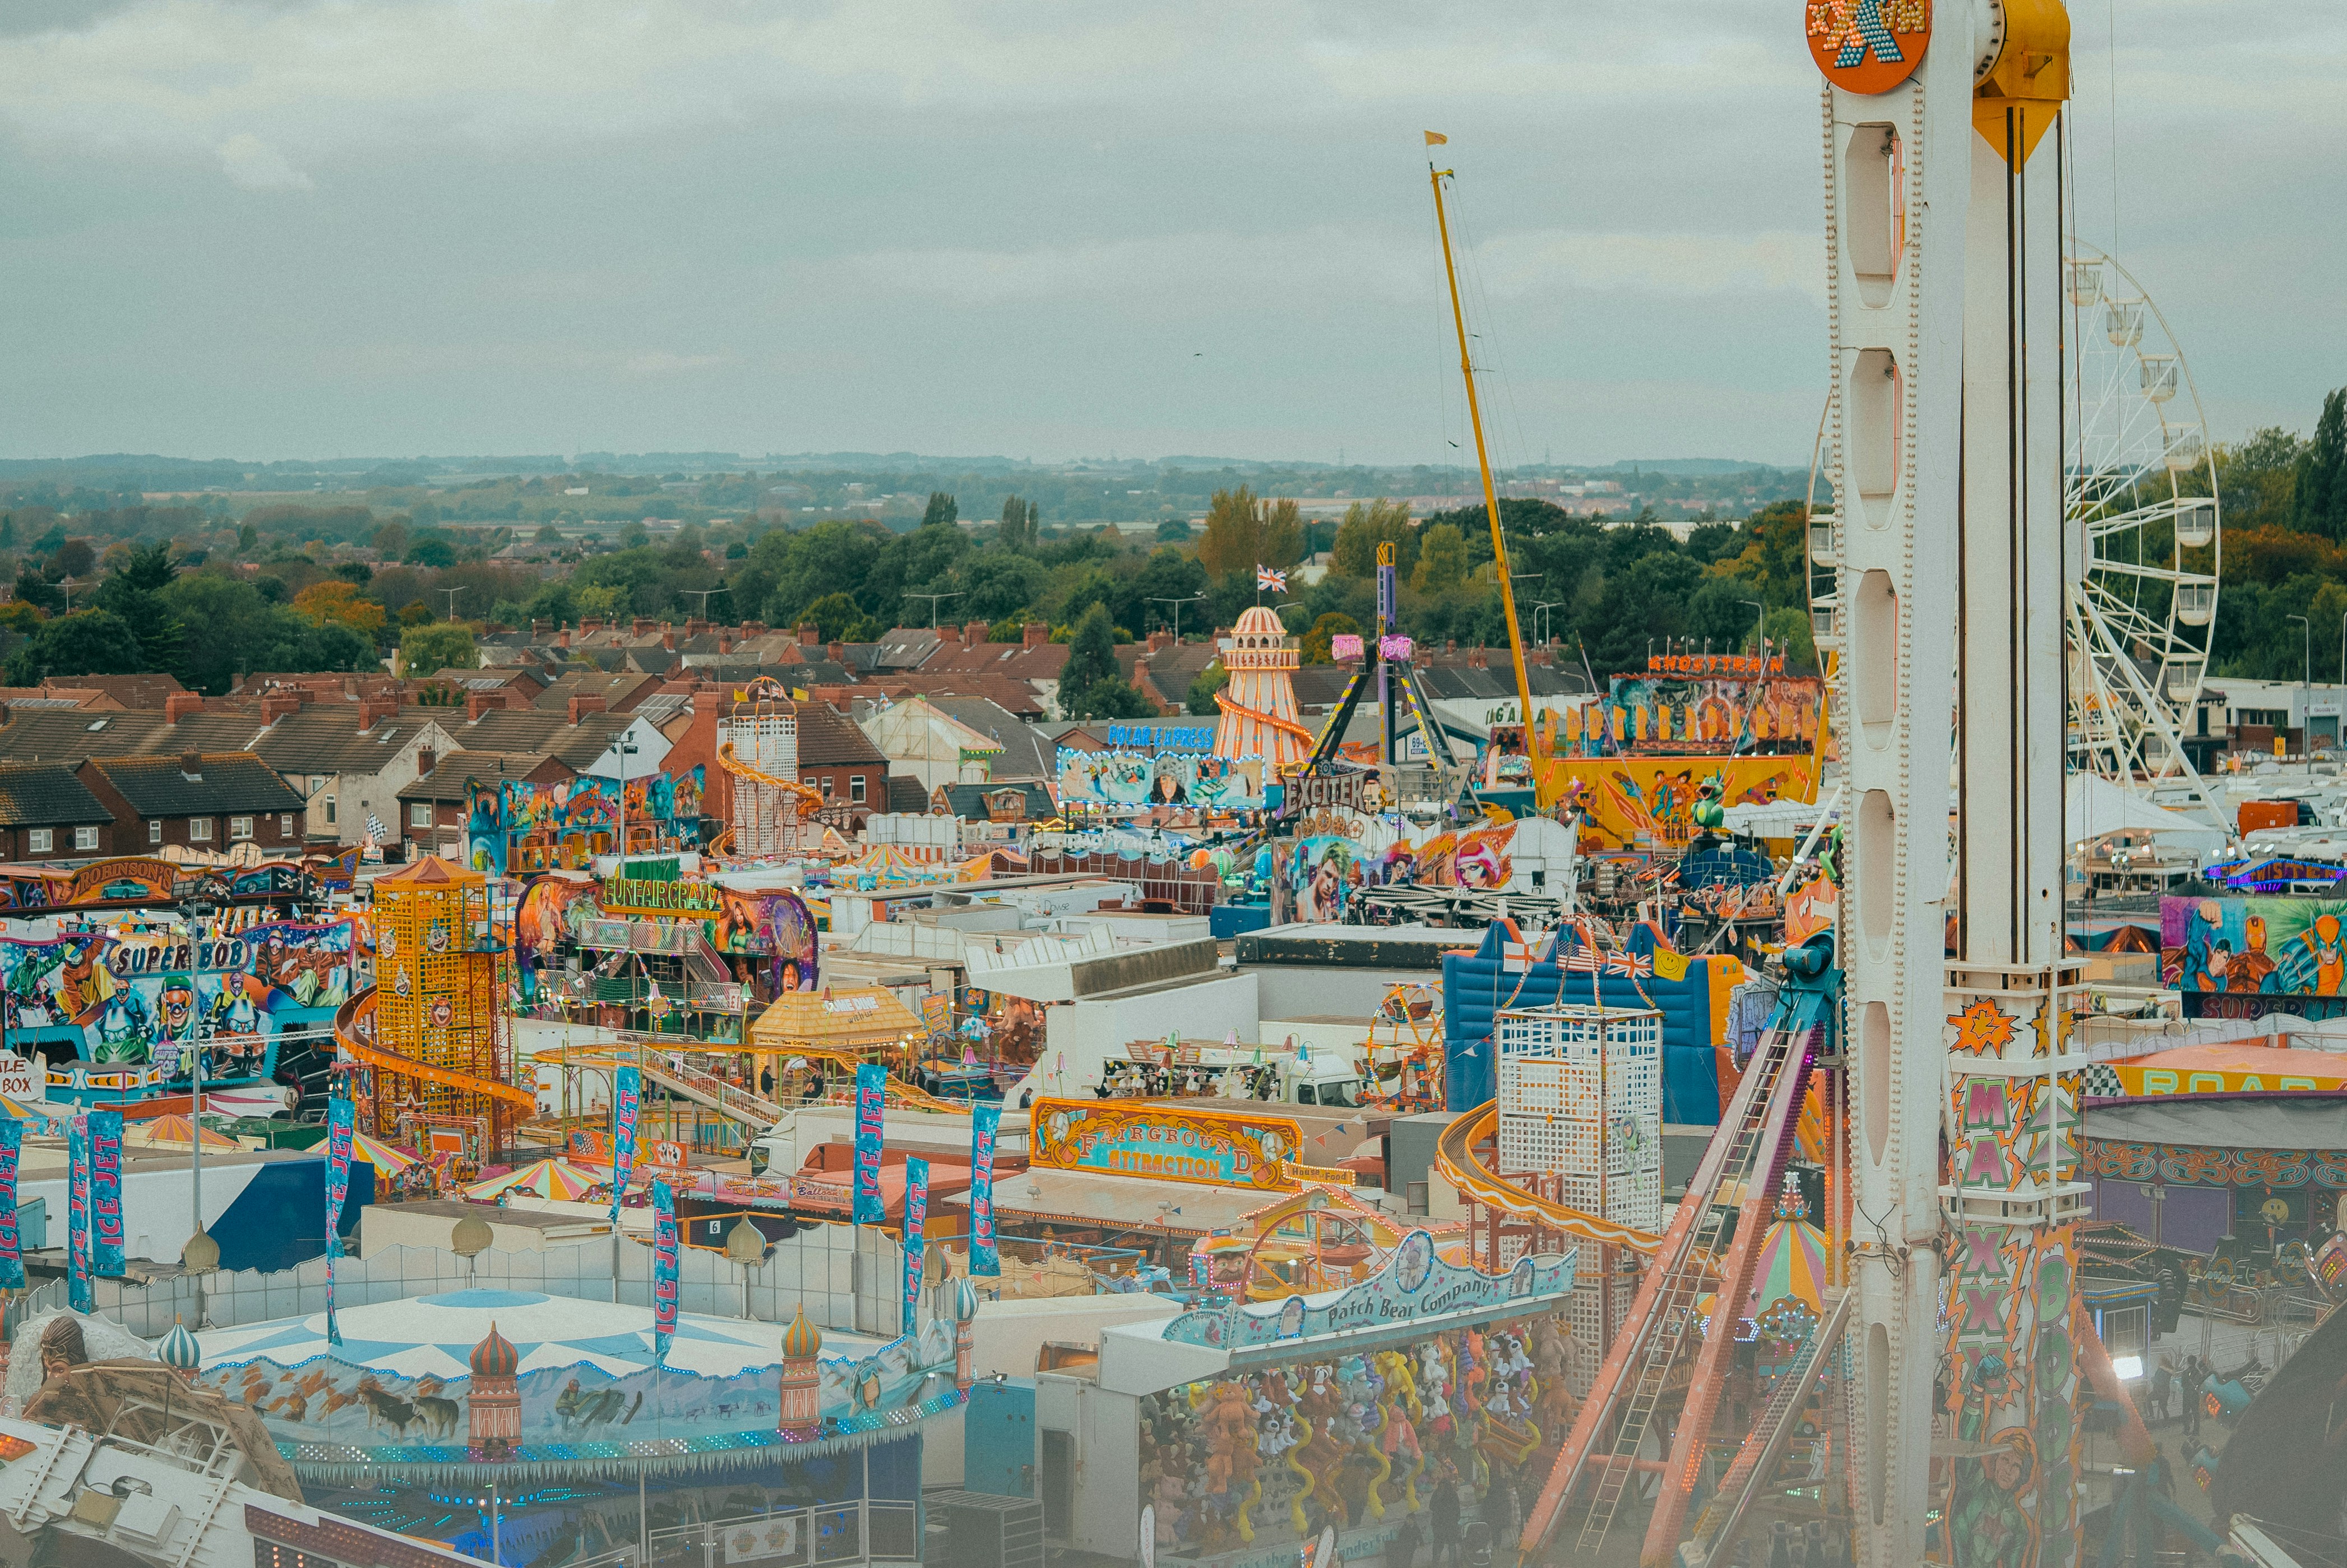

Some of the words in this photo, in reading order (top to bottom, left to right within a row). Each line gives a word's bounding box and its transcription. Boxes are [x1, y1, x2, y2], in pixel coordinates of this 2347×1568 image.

[1380, 636, 1411, 659] FEAR
[1648, 655, 1717, 672] GHOST
[1721, 656, 1783, 672] TRAN
[1108, 725, 1150, 746] POLAR
[1154, 727, 1214, 748] EXPRESS
[1285, 773, 1367, 812] EXCITER
[79, 862, 173, 894] ROBINSON'S
[2251, 861, 2337, 881] TWISTER
[605, 878, 668, 908] FUNFAIR
[668, 879, 716, 911] CRAZY
[1044, 900, 1070, 912] Dowse
[114, 944, 192, 974] SUPER
[197, 938, 243, 972] BOB
[730, 995, 739, 1009] £1
[852, 996, 879, 1010] DINE
[2201, 996, 2347, 1021] SUPERHE
[848, 1013, 864, 1024] with
[2, 1077, 31, 1094] BOX
[618, 1089, 638, 1142] JET
[860, 1087, 882, 1141] JET
[94, 1135, 119, 1189] JET
[331, 1122, 352, 1176] JET
[976, 1131, 992, 1188] JET
[1080, 1126, 1253, 1174] FAIRGROUND
[1109, 1150, 1219, 1177] ATTRACTION
[675, 1169, 700, 1182] PRIZES
[725, 1177, 754, 1190] QUALITY
[756, 1177, 782, 1194] PRIZES
[861, 1150, 880, 1197] ICE
[1292, 1167, 1320, 1177] House
[1325, 1171, 1346, 1181] Food
[71, 1158, 87, 1219] JET
[797, 1186, 840, 1197] Balloon
[96, 1197, 124, 1247] ICE
[712, 1222, 717, 1233] 6
[976, 1197, 996, 1248] ICE
[655, 1208, 677, 1270] JET
[72, 1228, 87, 1282] ICE
[655, 1279, 677, 1335] ICE
[1328, 1299, 1373, 1328] Patch
[1378, 1298, 1414, 1319] Bear
[1420, 1279, 1491, 1315] Company
[1169, 1324, 1180, 1336] Let
[1265, 1551, 1289, 1566] the
